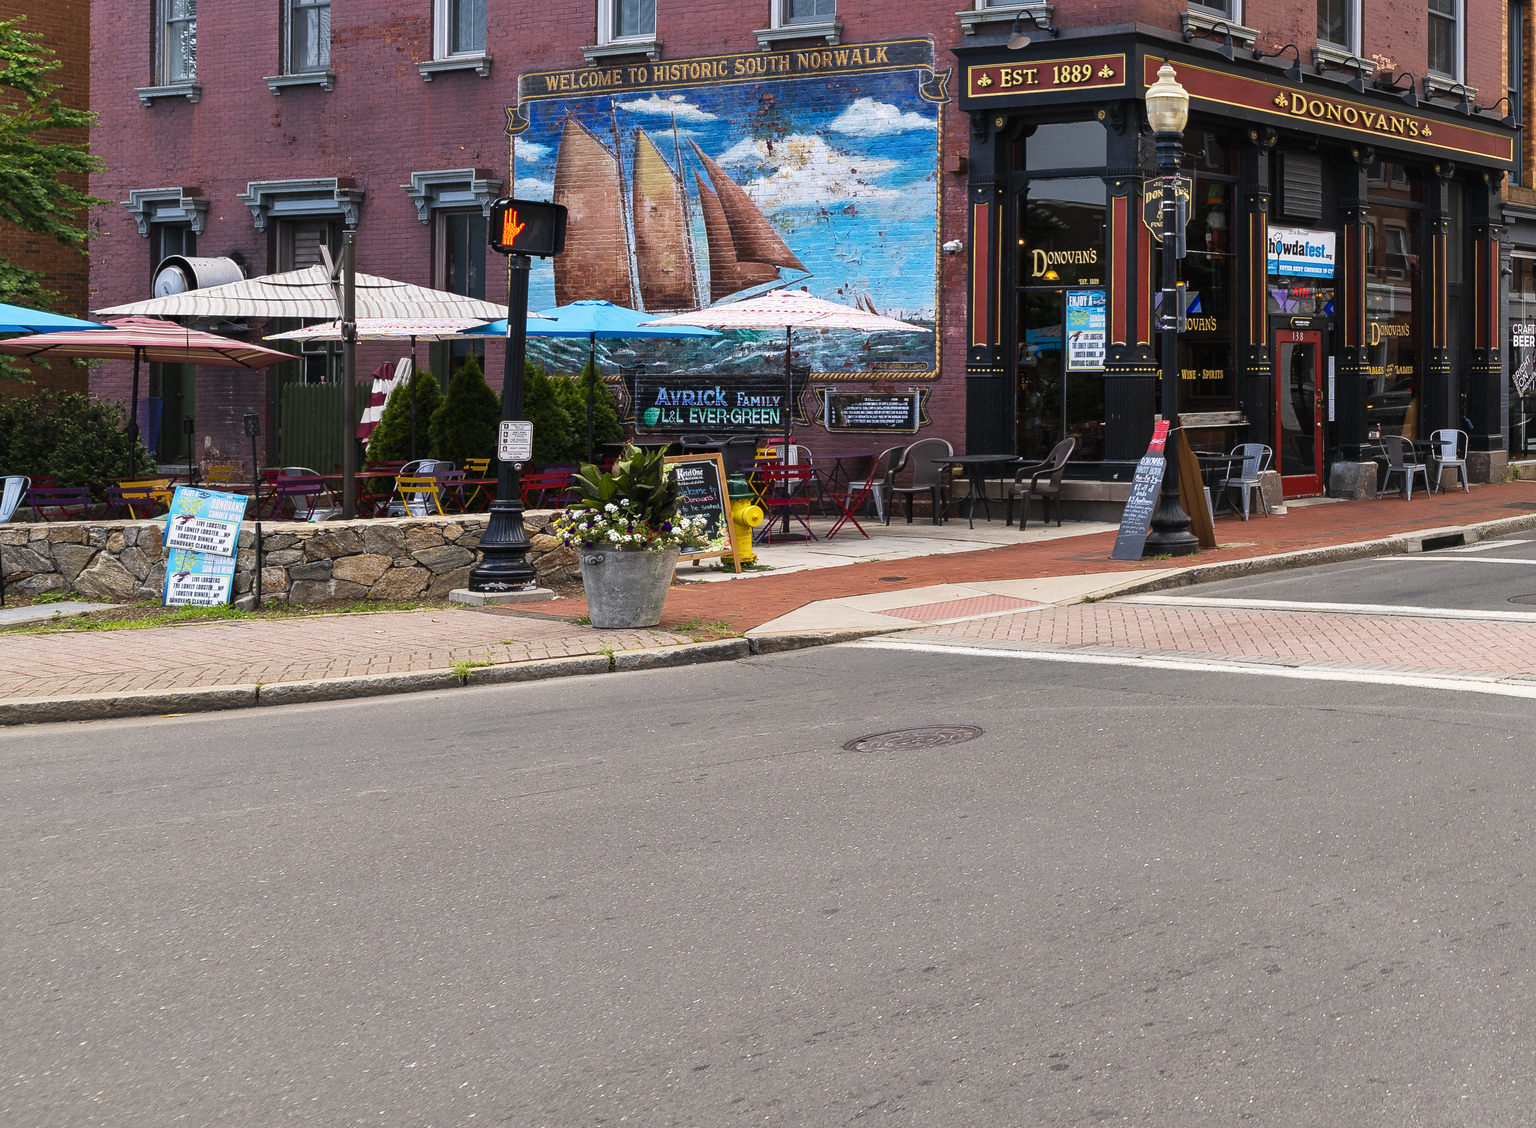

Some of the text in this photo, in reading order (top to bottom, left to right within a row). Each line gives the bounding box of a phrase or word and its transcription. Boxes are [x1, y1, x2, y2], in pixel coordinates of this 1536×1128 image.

[545, 46, 889, 91] WELCOME TO HISTORIC SOUTH NORWALK
[1000, 64, 1093, 88] EST. 1889
[1290, 92, 1419, 137] DONOVAN'S
[1031, 247, 1097, 277] DONOVAN'S
[1292, 286, 1310, 298] ATM
[1069, 295, 1087, 306] ENJOY
[1185, 315, 1217, 331] OVAN'S
[1512, 323, 1536, 335] CRAFT
[1292, 331, 1304, 341] 138
[1370, 322, 1410, 346] DONOVAN'S
[1513, 335, 1535, 347] BEER
[1181, 368, 1224, 380] WINE SPIRITS
[1518, 370, 1529, 387] ON
[655, 385, 781, 407] AVRICK FAMILY
[661, 407, 685, 424] L&L
[709, 485, 717, 493] to
[211, 498, 244, 513] DONOVANS
[208, 510, 229, 521] SUMMER
[206, 521, 227, 530] LOBSTERS
[170, 539, 195, 548] DONOVANS
